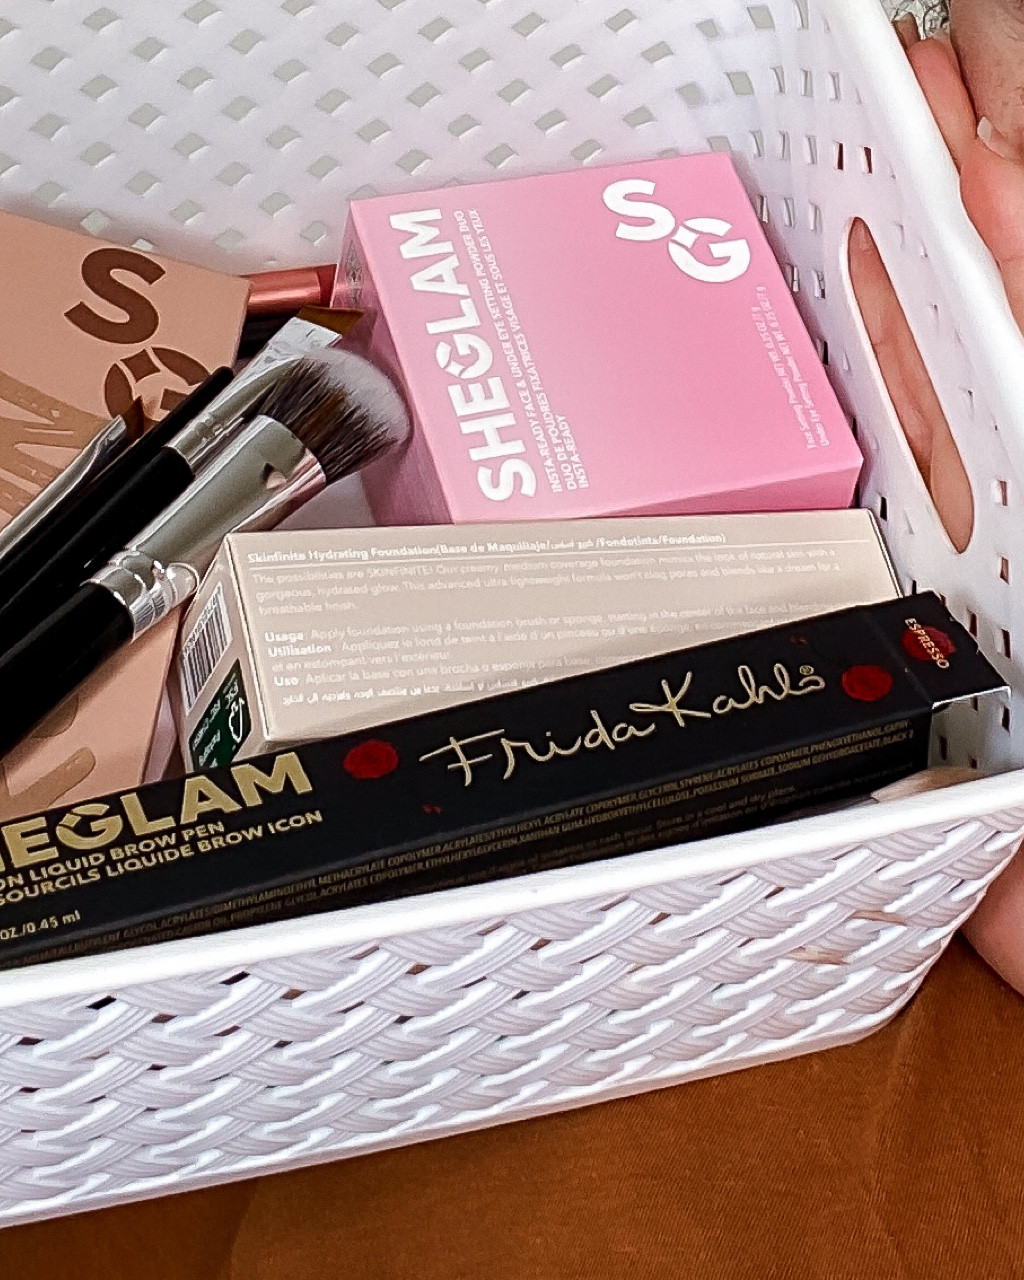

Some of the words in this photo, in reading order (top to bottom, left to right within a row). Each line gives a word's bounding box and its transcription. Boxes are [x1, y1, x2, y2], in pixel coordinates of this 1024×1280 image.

[452, 209, 470, 232] DUO
[467, 208, 486, 235] YEUX
[460, 232, 486, 277] POWDER
[482, 251, 503, 280] SOUS
[476, 278, 502, 319] SETTING
[493, 280, 508, 293] ET
[387, 207, 542, 504] SHEGLAM
[499, 340, 523, 378] UNDER
[512, 378, 527, 388] &
[516, 388, 538, 418] FACE
[533, 392, 562, 443] POUDRES
[527, 418, 564, 492] INSTA-READY
[552, 442, 569, 460] DE
[553, 413, 591, 489] INSTA-READY
[559, 461, 579, 490] DUO
[904, 617, 950, 669] ESPRESSO
[419, 710, 656, 787] Frida
[0, 751, 313, 871] EGLAM
[29, 852, 106, 881] LIQUID
[110, 832, 177, 860] BROW
[182, 820, 225, 842] PEN
[106, 844, 195, 878] LIQUIDE
[197, 824, 264, 854] BROW
[268, 810, 324, 835] ICON
[62, 909, 81, 924] ml
